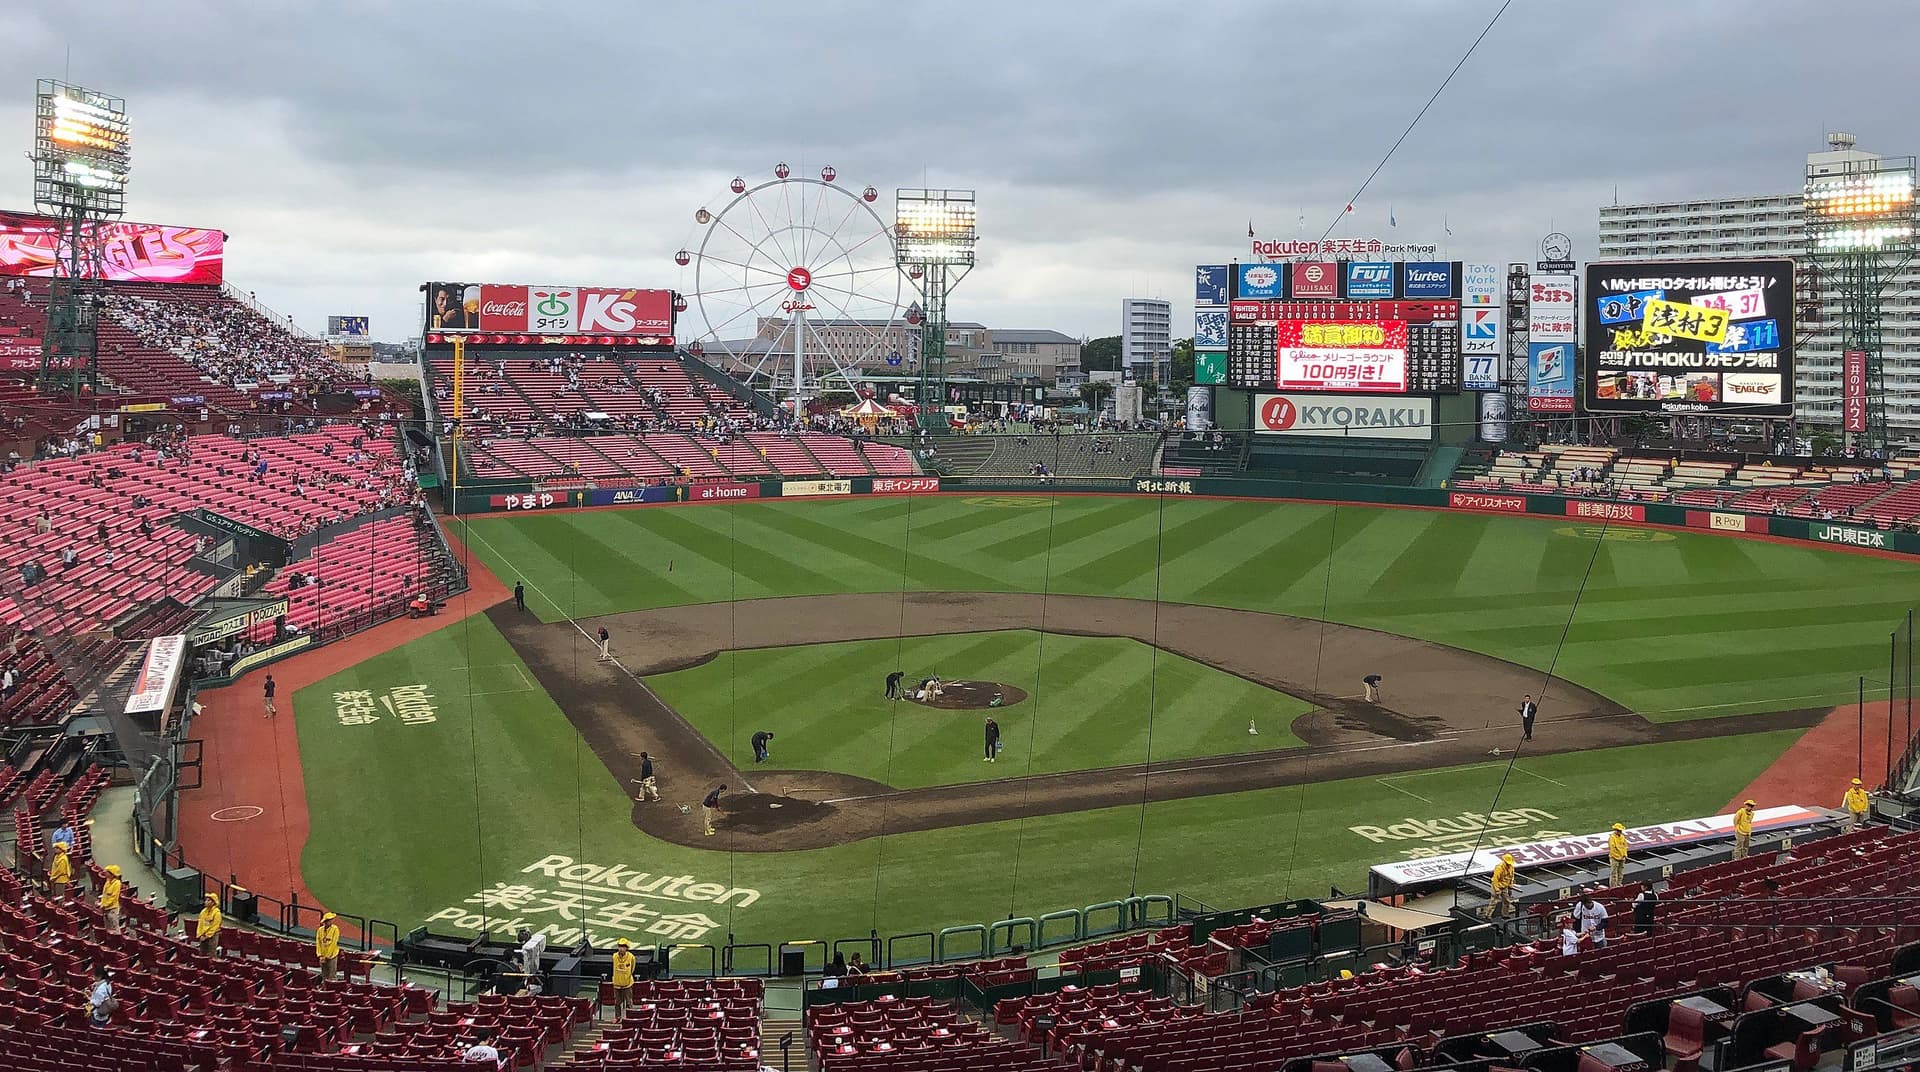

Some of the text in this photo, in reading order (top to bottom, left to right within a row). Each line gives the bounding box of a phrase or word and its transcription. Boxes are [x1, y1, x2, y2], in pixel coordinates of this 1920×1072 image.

[1253, 239, 1436, 256] Rakuten 楽天生命 Park Miyagi
[1351, 266, 1390, 282] Fuji
[1408, 269, 1447, 282] Yurtec
[1464, 276, 1494, 284] Work
[1468, 285, 1495, 294] Group
[1532, 284, 1572, 302] まるまつ
[782, 300, 816, 314] Glico
[1602, 296, 1642, 319] 田中
[1740, 294, 1759, 314] 37
[1532, 322, 1572, 332] かに政宗
[1651, 304, 1705, 334] 浅村
[1704, 316, 1722, 336] 3
[1754, 324, 1772, 346] 11
[1466, 342, 1496, 350] カメイ
[1290, 350, 1394, 362] Glico メリーゴーラウンド
[1600, 352, 1624, 360] 2019
[1632, 352, 1777, 368] TOHOKU カモフラ柄!
[1302, 364, 1384, 379] 100円引き!
[1469, 358, 1493, 374] 77
[1734, 385, 1769, 394] EAGLES
[1850, 353, 1860, 429] 三井のリハウス
[1662, 402, 1690, 410] Rakuten
[1302, 406, 1424, 426] KYORAKU
[818, 482, 850, 492] 東北電力
[872, 480, 938, 492] 東京インテリア
[1136, 480, 1192, 494] 河北新報
[505, 493, 554, 510] やまや
[614, 490, 632, 499] ANA
[1466, 496, 1522, 510] アイリスオーヤマ
[1577, 503, 1632, 520] 能美防災
[1715, 516, 1741, 527] R Pay
[234, 524, 260, 536] バッテリー
[1818, 526, 1884, 547] JR東日本
[332, 690, 380, 726] 楽天生命
[390, 685, 438, 726] Rakuten
[1348, 808, 1560, 843] Rakuten
[521, 854, 762, 908] Rakuten
[464, 882, 720, 940] 楽天生命
[424, 907, 538, 936] Park
